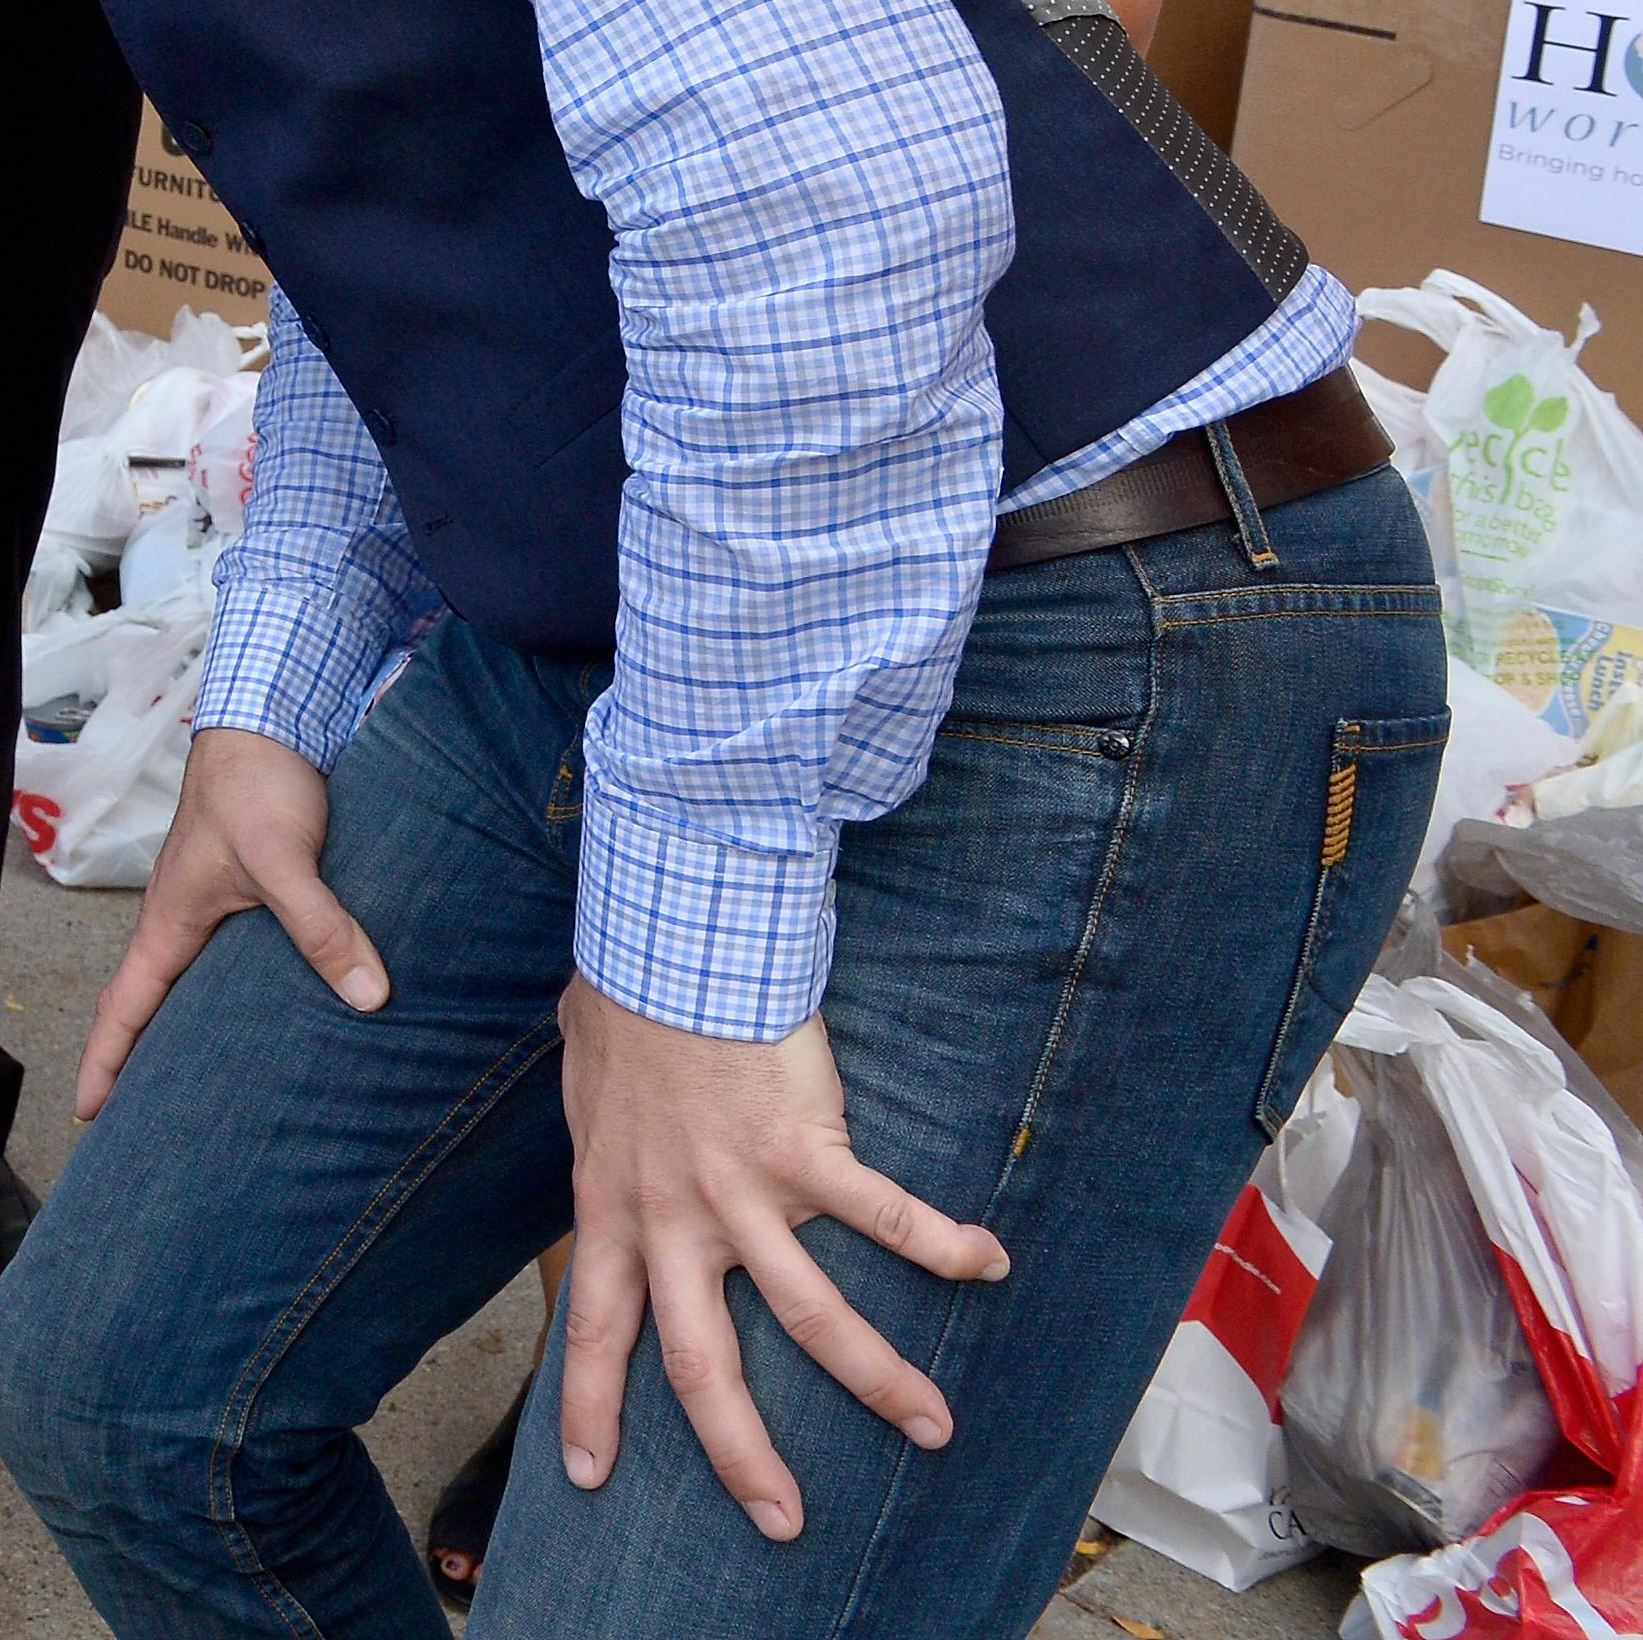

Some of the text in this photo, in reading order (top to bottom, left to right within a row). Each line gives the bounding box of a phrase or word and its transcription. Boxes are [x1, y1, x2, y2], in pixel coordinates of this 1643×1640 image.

[1498, 144, 1605, 180] Bringing
[135, 165, 221, 203] URNIT
[125, 210, 152, 234] LE
[158, 218, 219, 248] Handle
[124, 248, 266, 300] DO NOT DROP
[1587, 654, 1614, 711] Lunch
